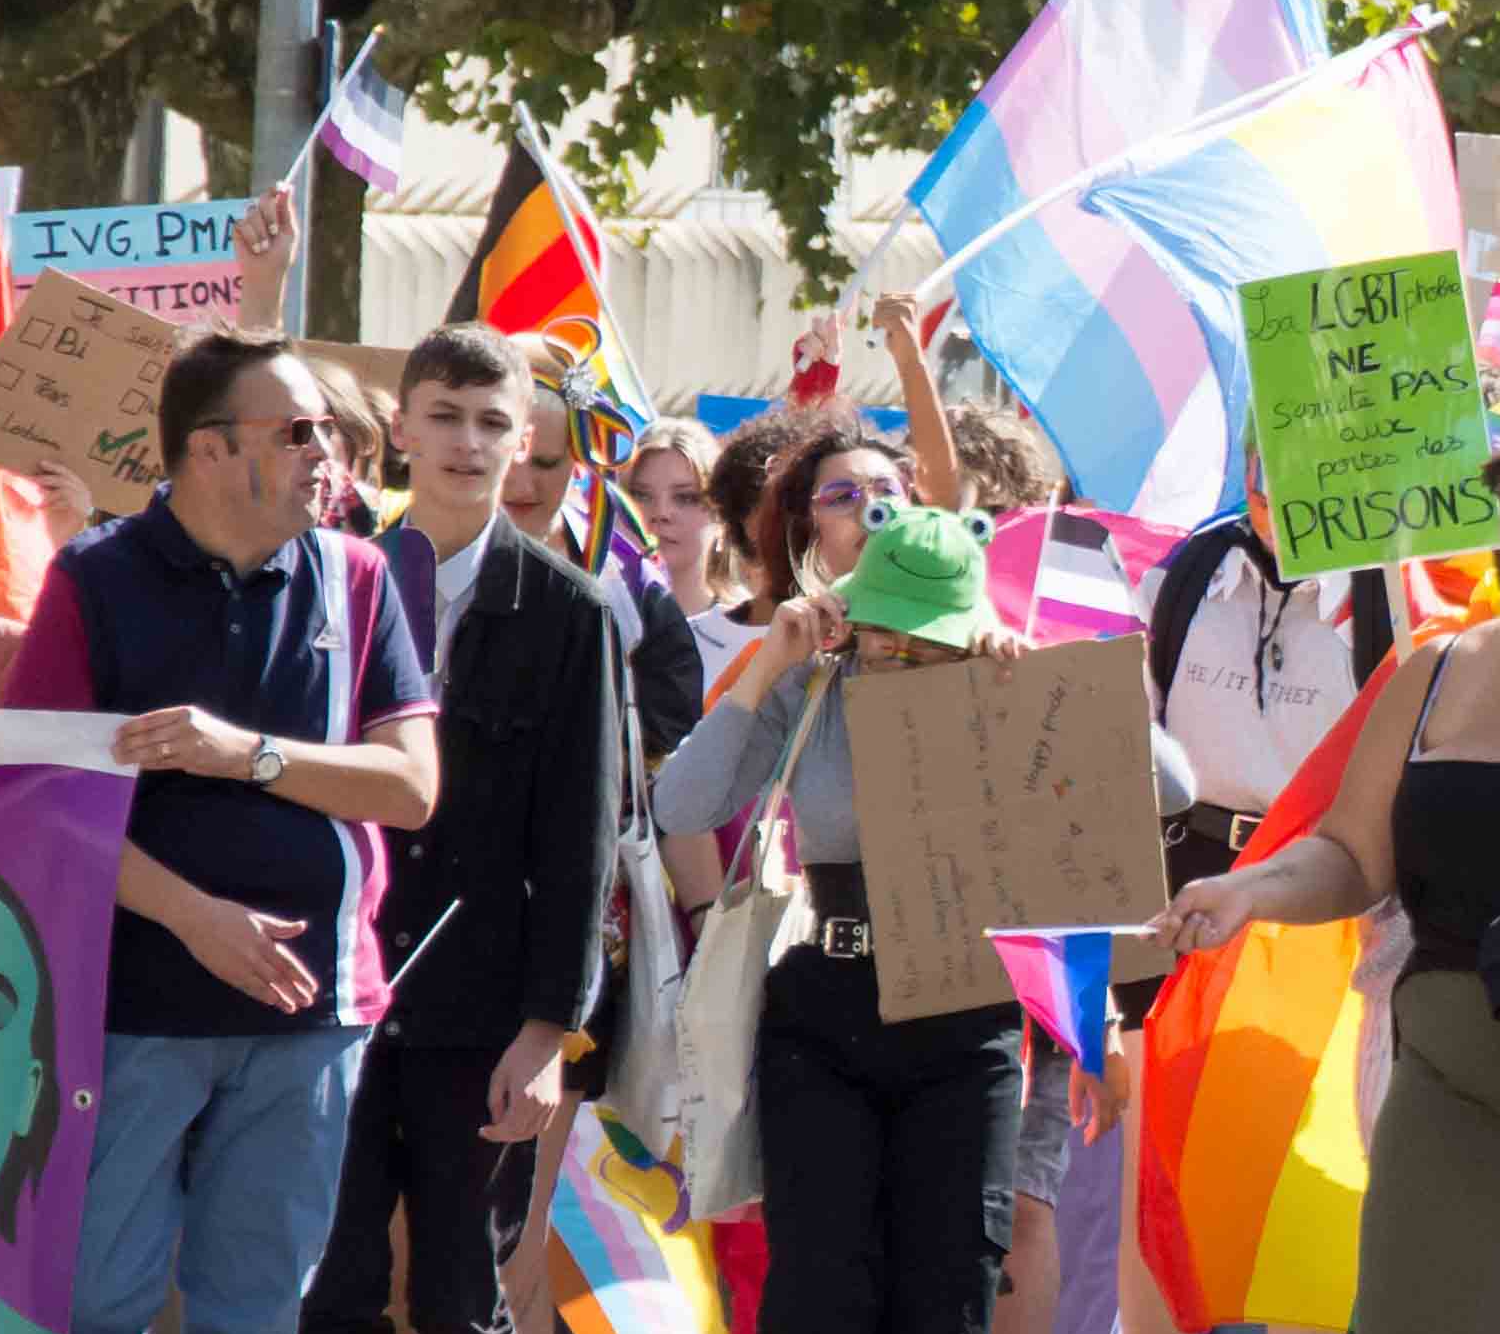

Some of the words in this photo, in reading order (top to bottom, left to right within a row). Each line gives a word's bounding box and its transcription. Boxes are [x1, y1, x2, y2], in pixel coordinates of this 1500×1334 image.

[32, 219, 140, 262] IVG,
[1241, 284, 1301, 342] La
[1328, 341, 1382, 380] NE
[1389, 365, 1470, 402] PAS
[1338, 417, 1417, 443] aux
[1280, 475, 1496, 560] PRISONS
